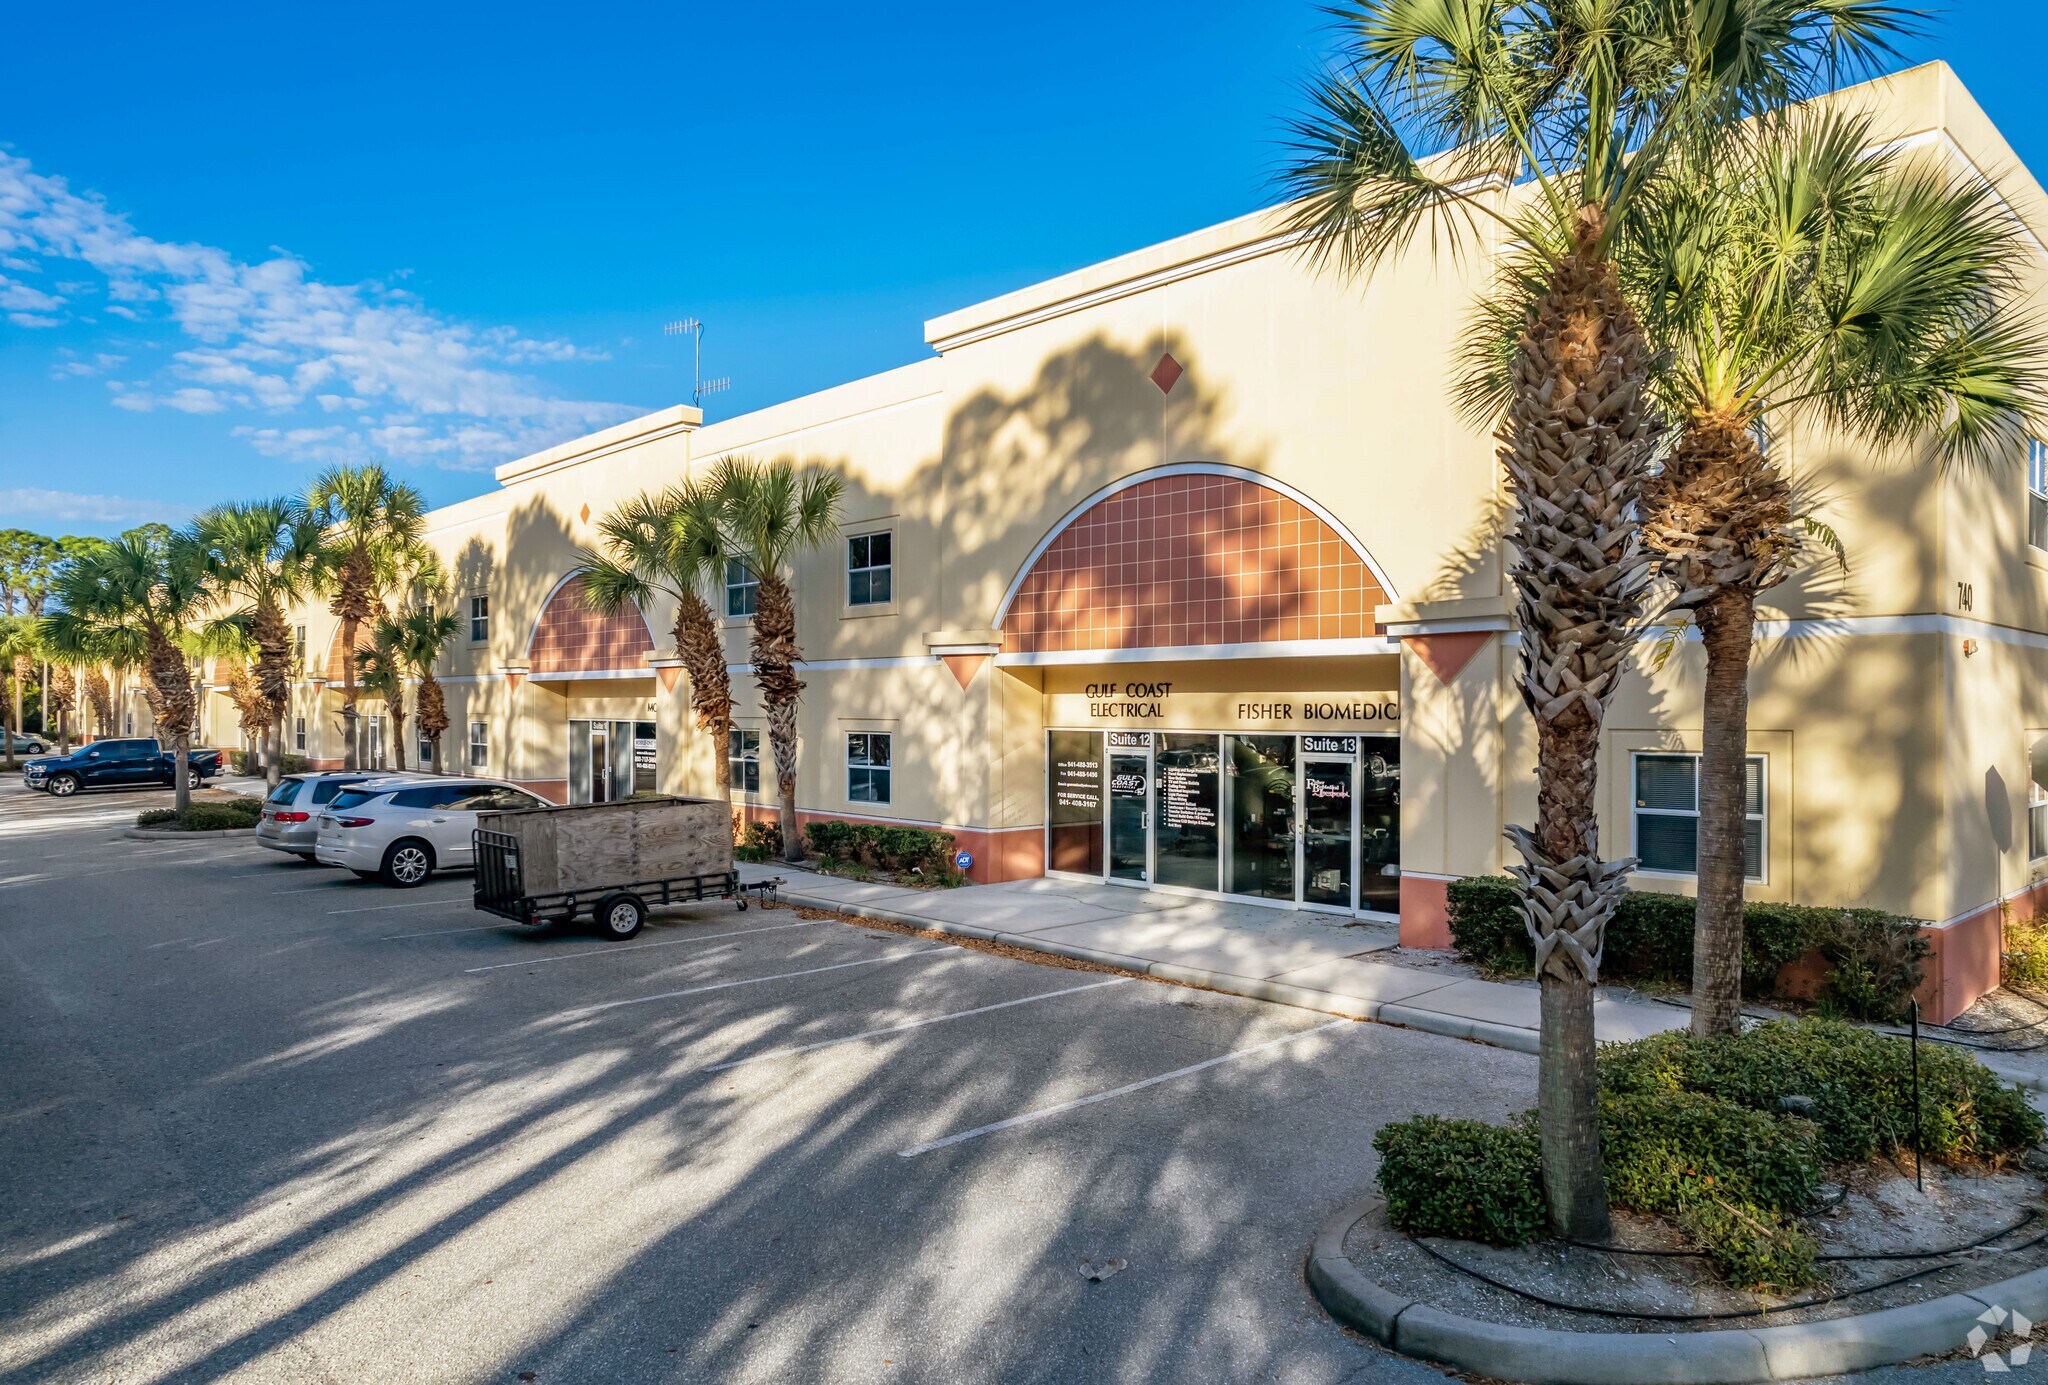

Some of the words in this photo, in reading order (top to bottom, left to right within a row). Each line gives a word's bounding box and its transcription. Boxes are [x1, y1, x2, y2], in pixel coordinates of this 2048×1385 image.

[1958, 582, 1972, 612] 740
[1086, 684, 1116, 698] GULF
[1126, 682, 1172, 698] COAST
[1090, 703, 1164, 717] ELECTRICAL
[1238, 704, 1292, 720] FISHER
[1304, 703, 1400, 720] BIOMEDIC
[1111, 733, 1136, 745] Suite
[1140, 734, 1150, 746] 12
[1304, 738, 1338, 751] Suite
[1342, 738, 1356, 752] 13
[1116, 774, 1137, 782] GULF
